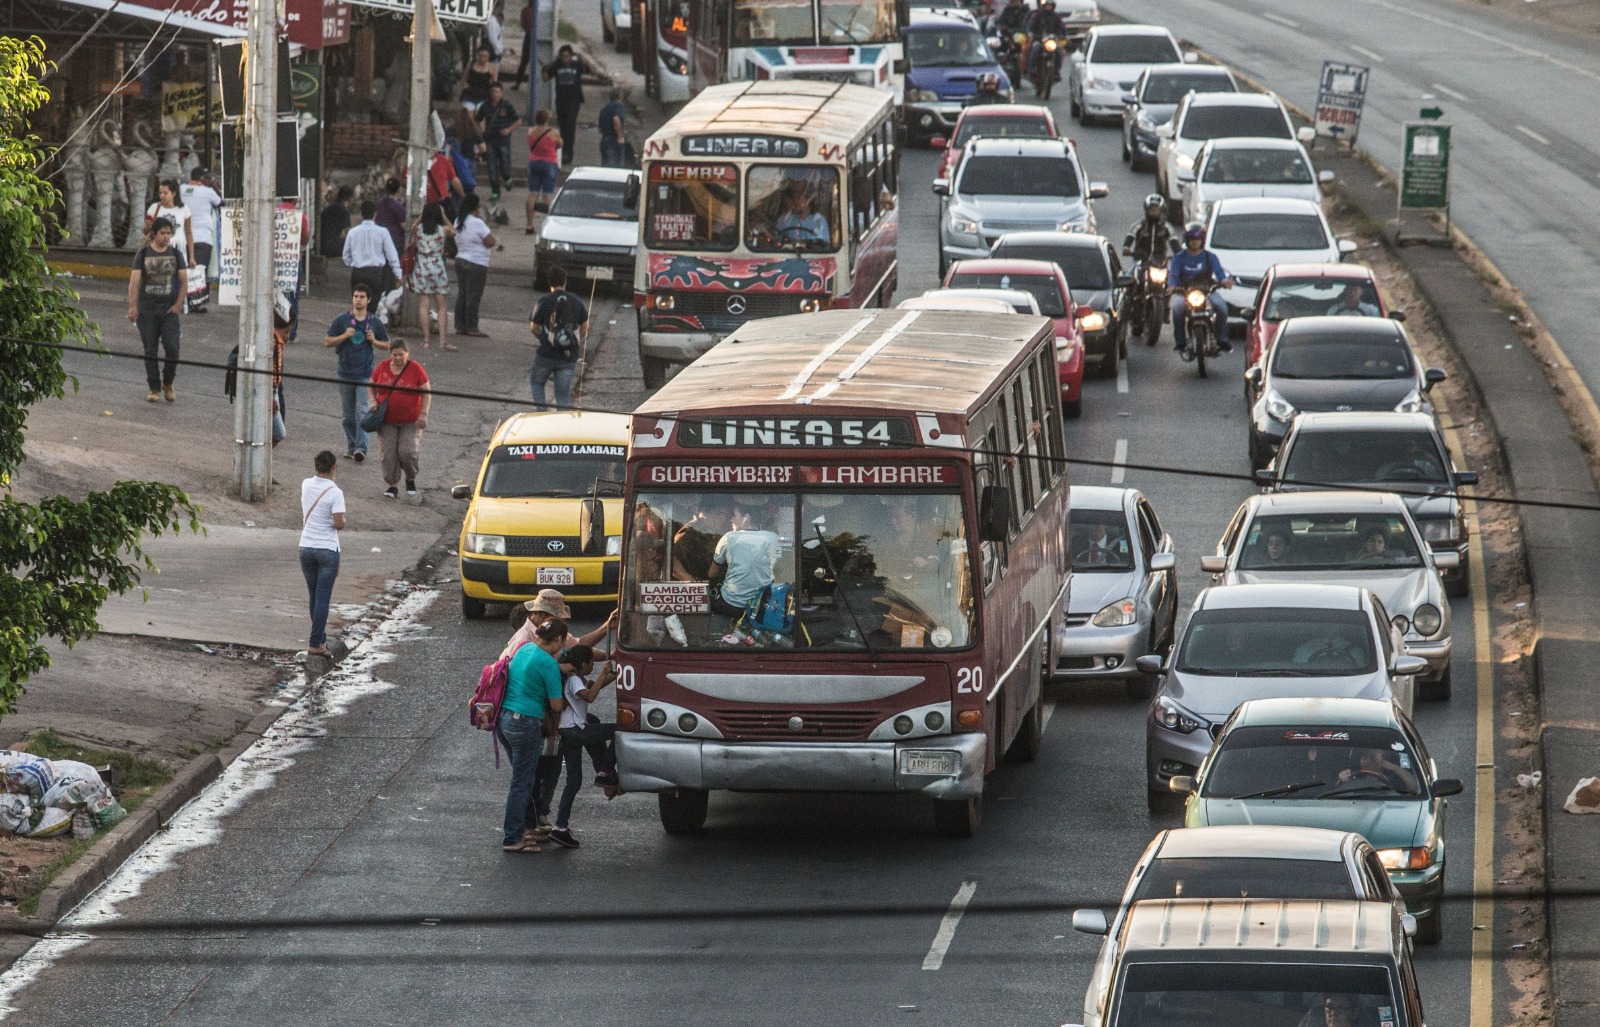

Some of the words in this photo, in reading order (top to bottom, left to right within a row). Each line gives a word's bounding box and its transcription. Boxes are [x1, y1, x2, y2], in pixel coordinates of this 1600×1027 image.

[288, 13, 300, 21] DE
[688, 138, 769, 154] LINEA
[701, 420, 834, 446] LINEA
[841, 421, 891, 445] 54
[508, 446, 534, 456] TAXI
[536, 445, 570, 455] RADIO
[573, 446, 624, 456] LAMBARE
[821, 466, 944, 483] LAMBARE
[539, 574, 554, 584] BUK
[556, 574, 571, 584] 928
[645, 586, 705, 594] LAMBARE
[644, 595, 703, 604] CACIQUE
[654, 604, 702, 612] YACHT
[616, 663, 635, 691] 20
[957, 665, 983, 694] 20
